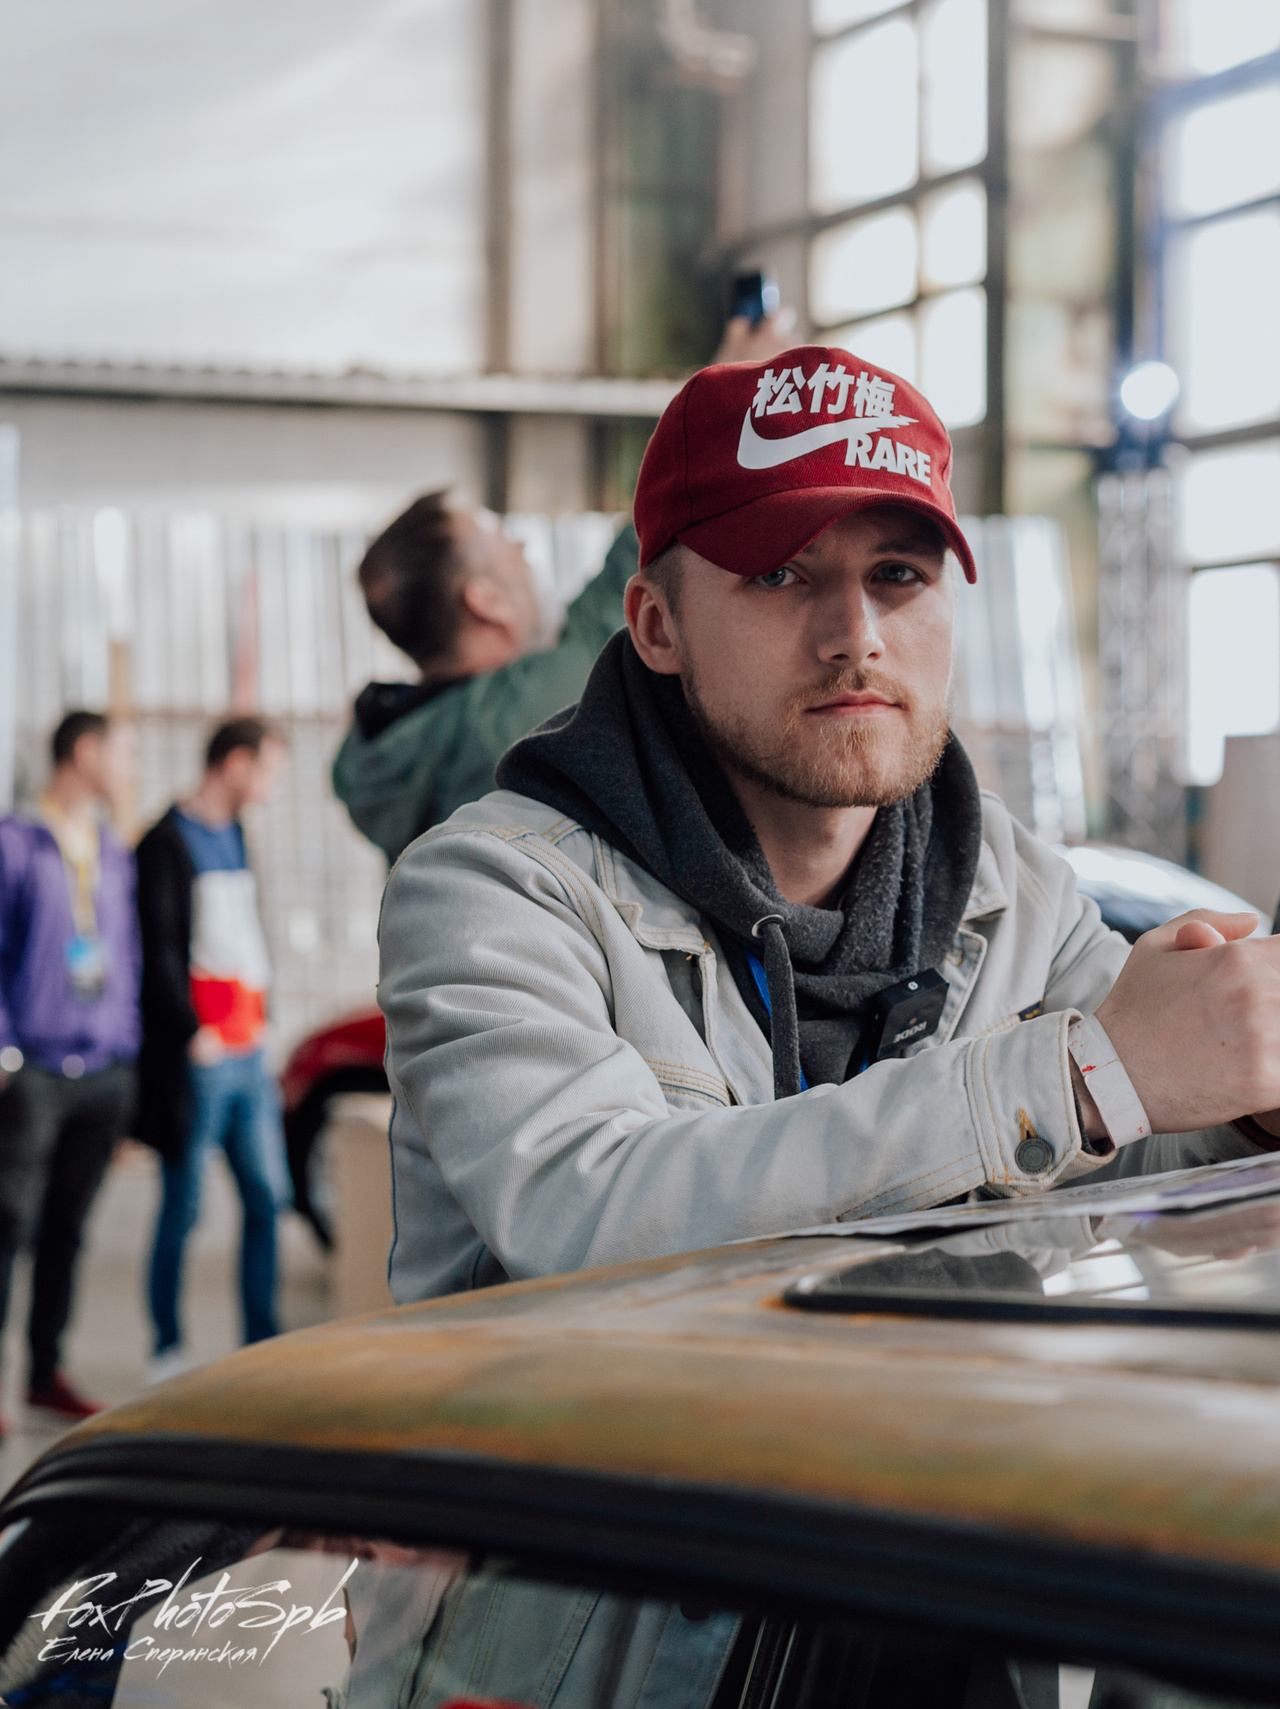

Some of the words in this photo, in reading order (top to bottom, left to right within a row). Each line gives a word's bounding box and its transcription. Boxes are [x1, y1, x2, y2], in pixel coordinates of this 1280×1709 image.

[752, 362, 896, 419] 松竹梅
[844, 432, 932, 488] RARE
